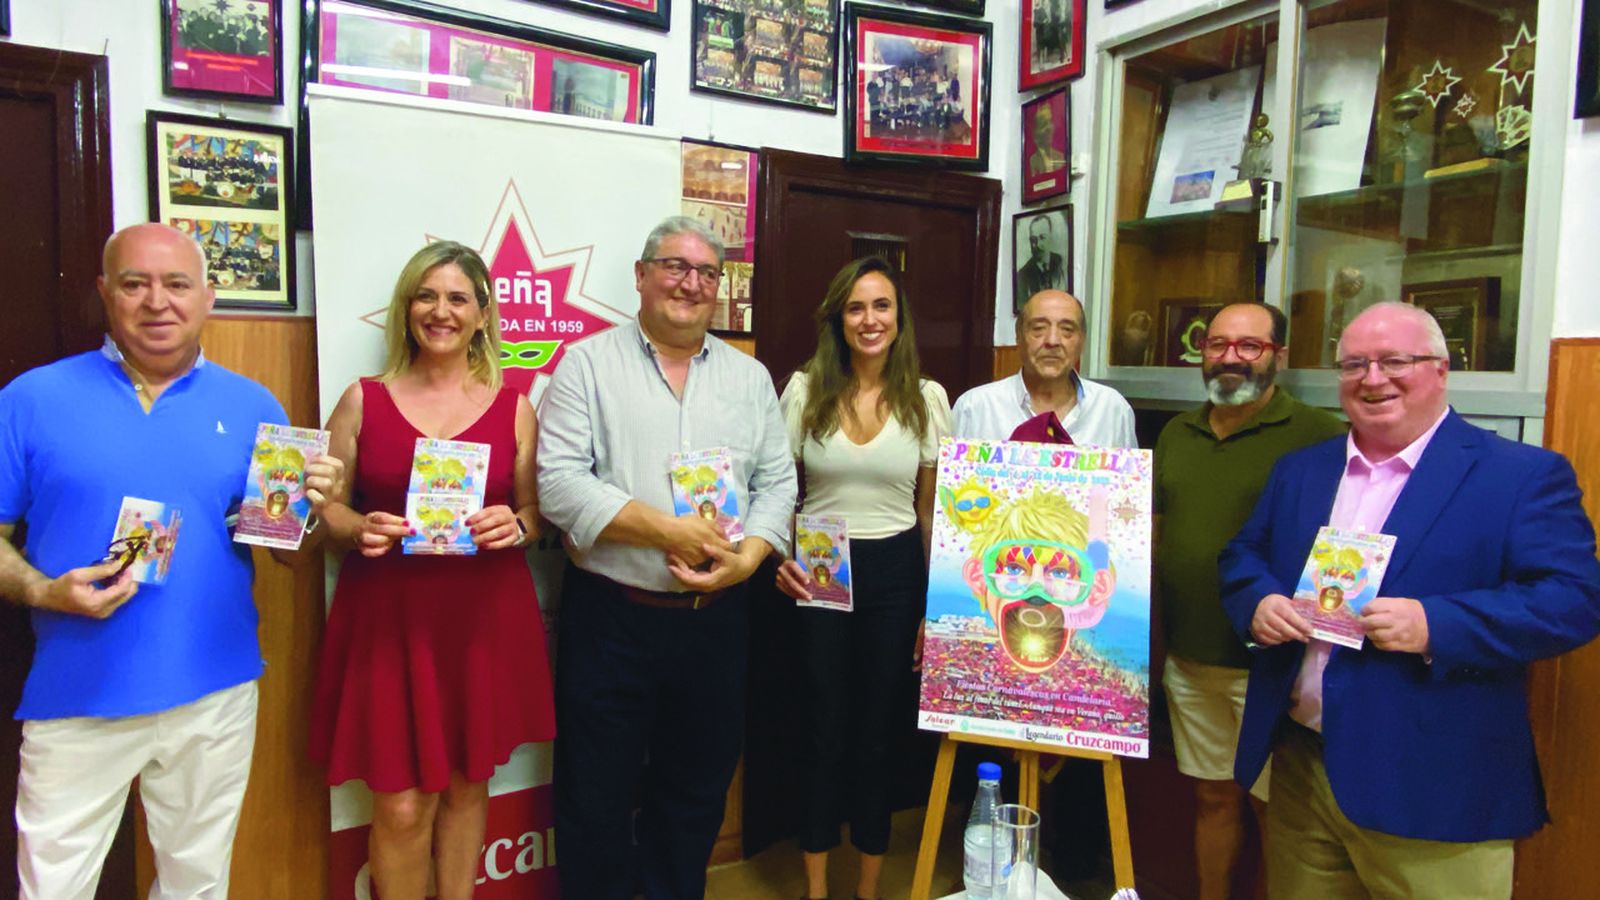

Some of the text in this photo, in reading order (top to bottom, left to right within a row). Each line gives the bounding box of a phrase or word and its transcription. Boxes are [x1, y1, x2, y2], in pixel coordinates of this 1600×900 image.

[494, 271, 552, 318] eña
[524, 320, 546, 333] EN
[550, 321, 584, 333] 1959
[953, 442, 1003, 464] PEÑA
[1039, 449, 1135, 474] ESTRELLA
[1026, 727, 1064, 742] Legendario
[1066, 731, 1142, 754] Cruzcampo
